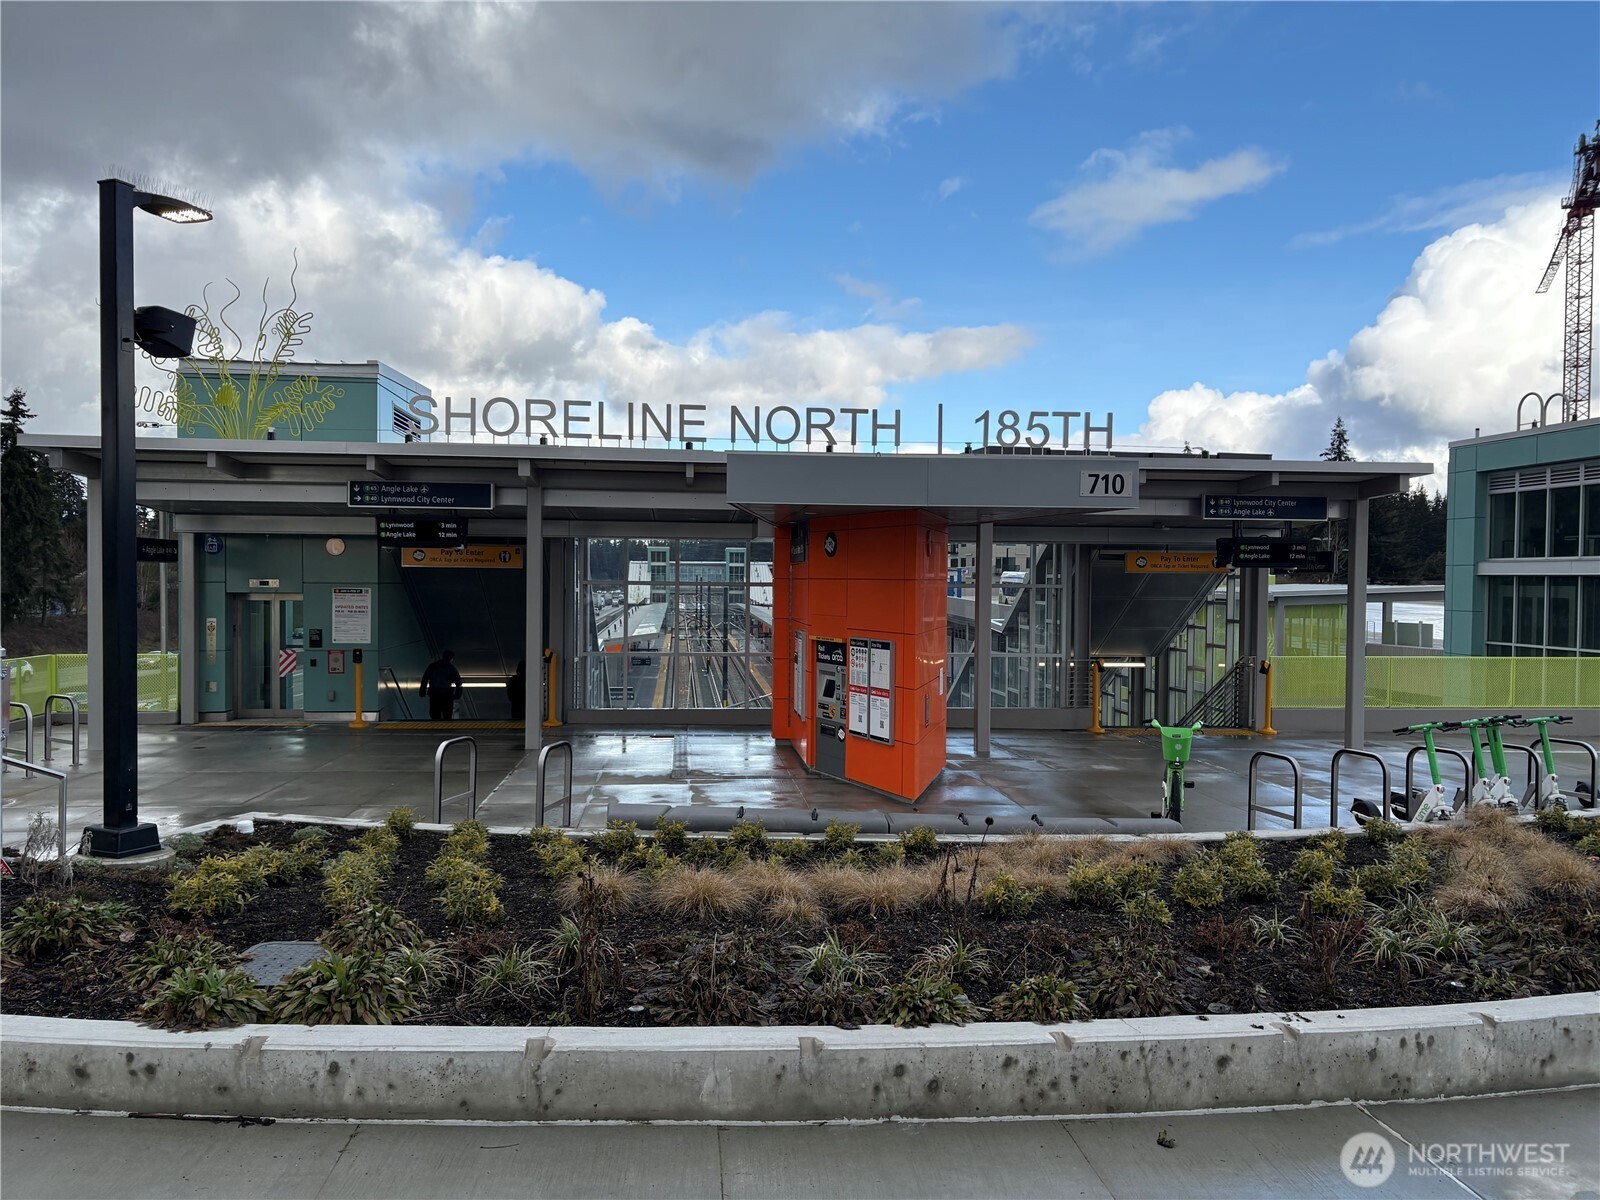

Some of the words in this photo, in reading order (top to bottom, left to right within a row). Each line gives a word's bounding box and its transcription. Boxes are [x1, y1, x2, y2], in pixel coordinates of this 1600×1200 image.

[408, 395, 707, 442] SHORELINE
[731, 405, 901, 446] NORTH
[975, 409, 1113, 449] 185TH
[1088, 473, 1124, 494] 710
[381, 485, 401, 494] Angle
[403, 485, 418, 493] Lake
[381, 496, 415, 504] Lynnwood
[417, 496, 430, 505] City
[1233, 499, 1263, 507] Lynnwood
[1264, 499, 1276, 507] City
[1233, 508, 1251, 517] Angle
[1252, 508, 1266, 516] Lake
[440, 549, 453, 558] Pay
[1160, 555, 1171, 563] Pay
[1416, 803, 1431, 822] Lime
